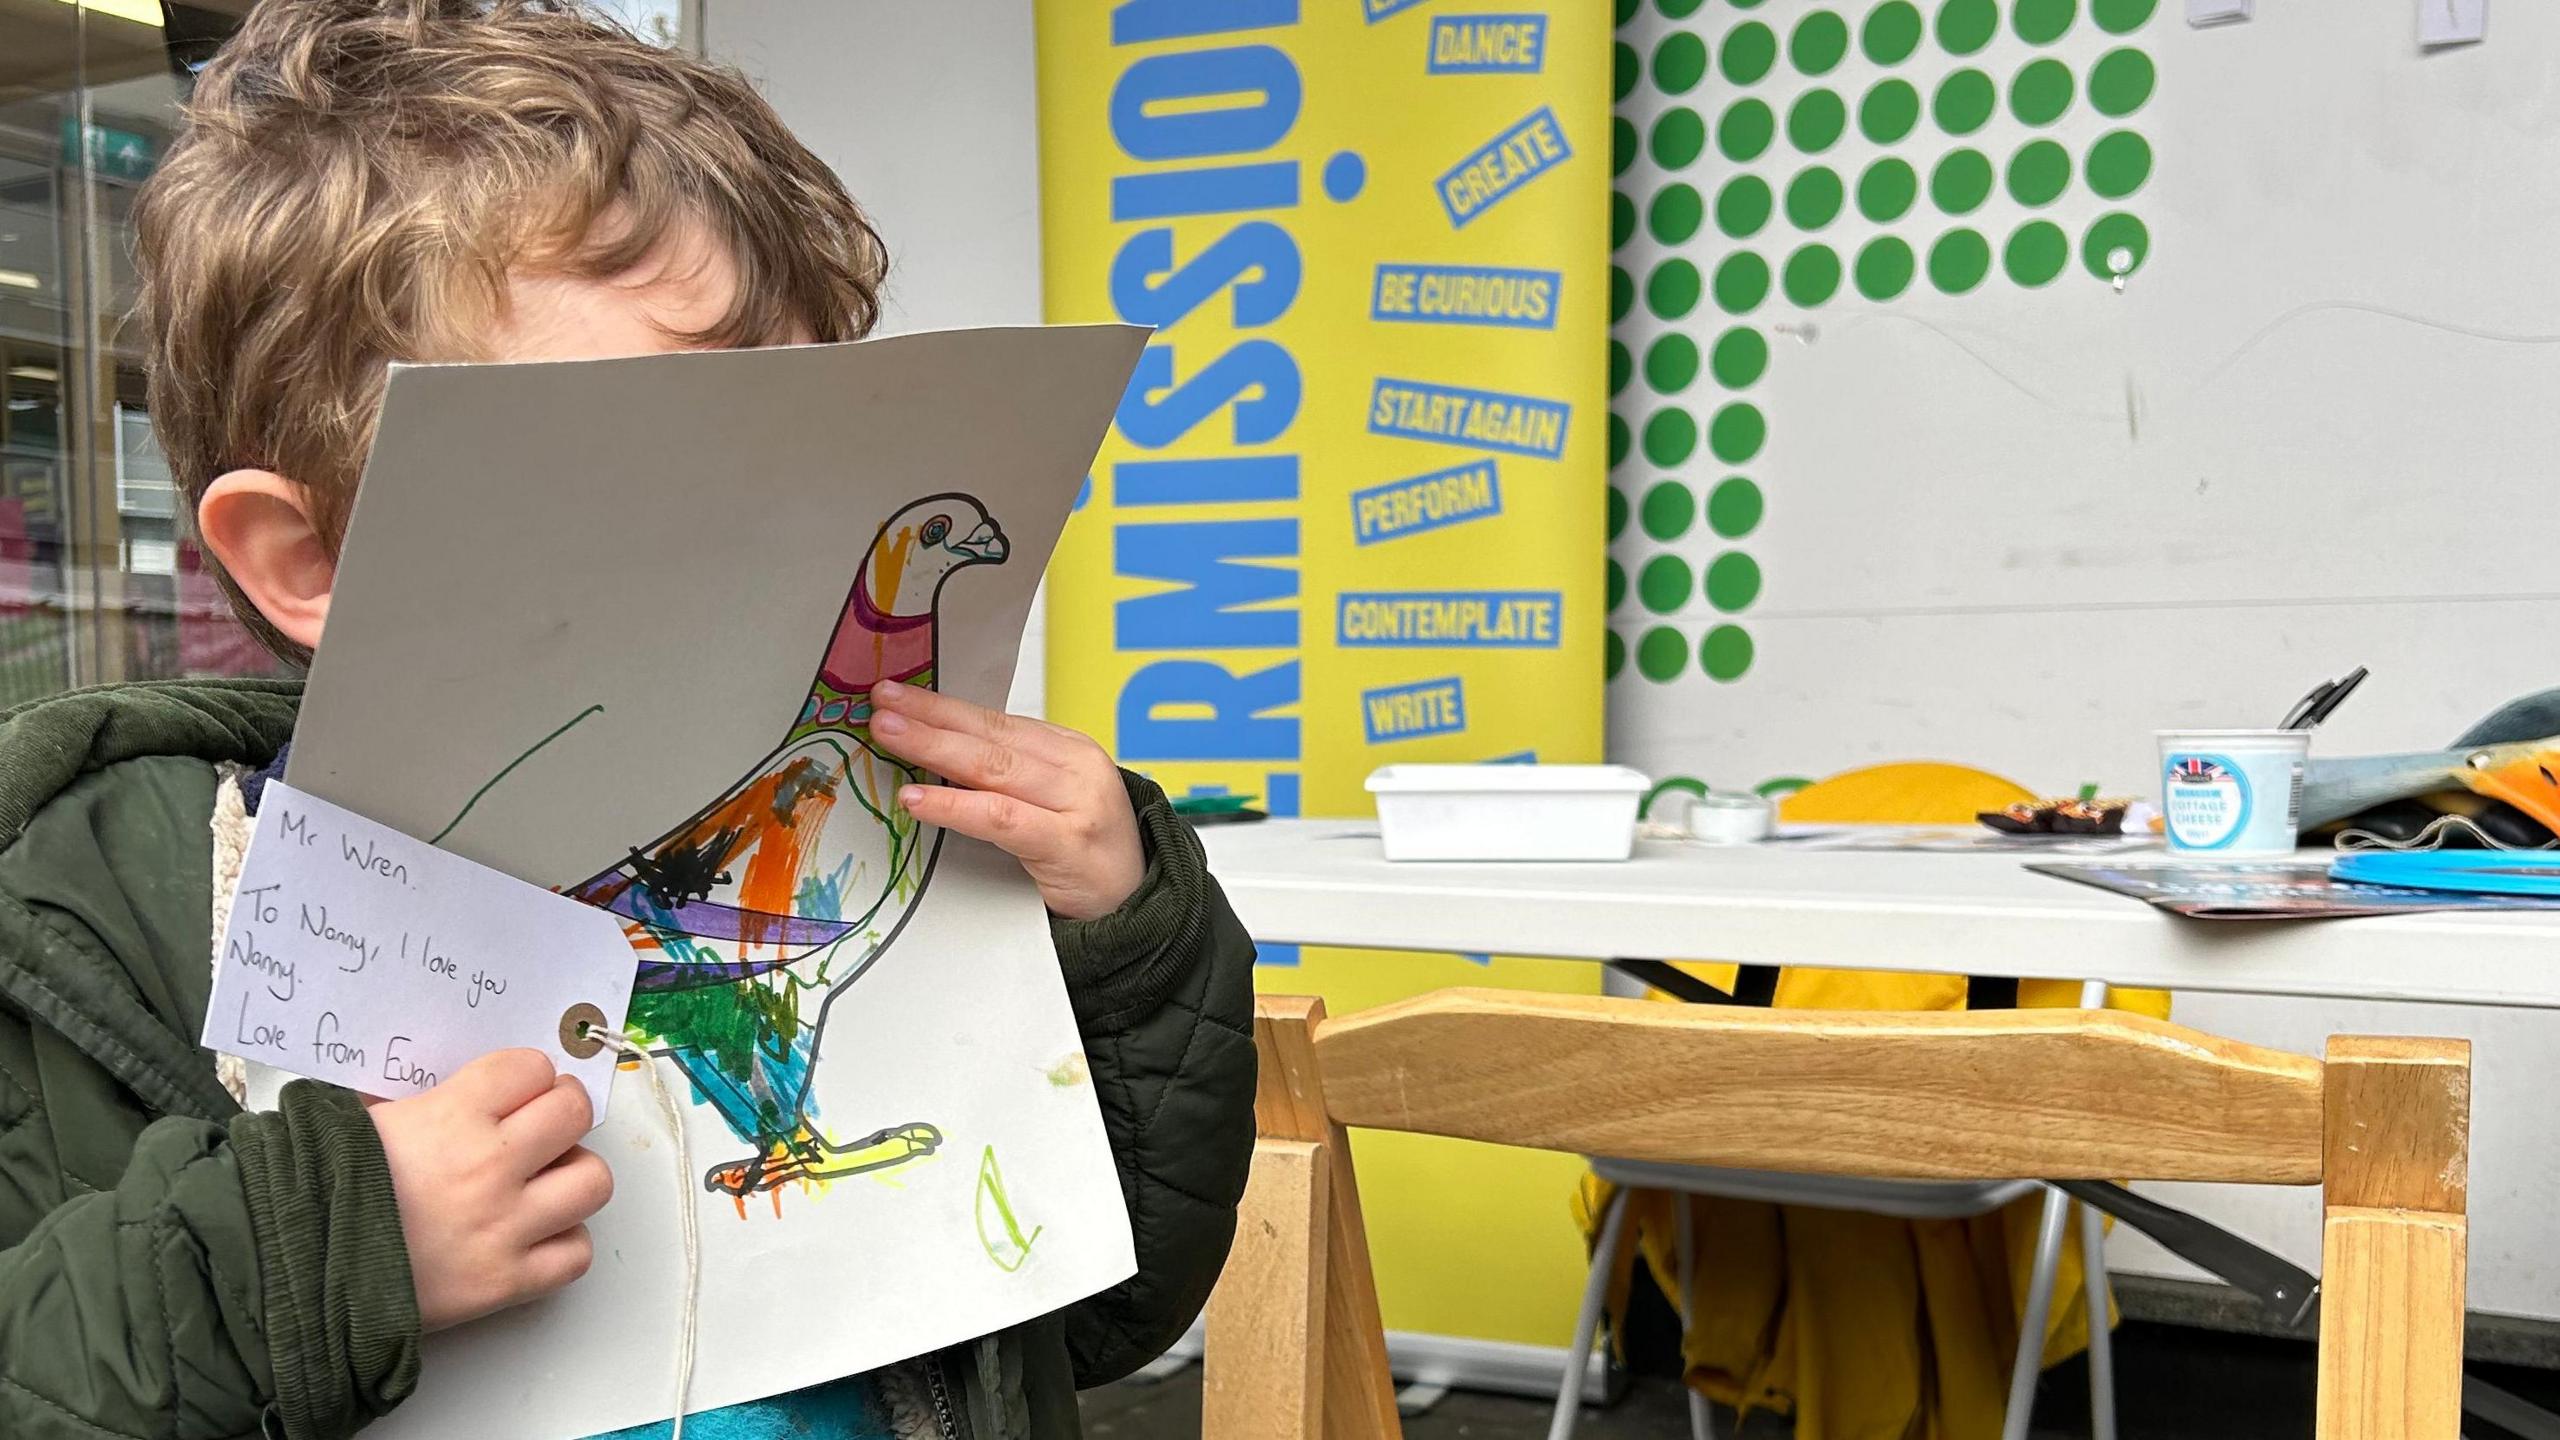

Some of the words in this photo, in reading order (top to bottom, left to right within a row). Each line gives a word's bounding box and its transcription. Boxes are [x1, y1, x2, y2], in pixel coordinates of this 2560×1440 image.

[1434, 24, 1536, 64] DANCE
[1446, 117, 1559, 215] CREATE
[1379, 273, 1416, 312] BE
[1418, 274, 1550, 320] CURIOUS
[1374, 386, 1466, 437] START
[1463, 400, 1561, 451] AGAIN
[1359, 468, 1492, 536] PERFORM
[1343, 600, 1552, 640] CONTEMPLATE
[1368, 686, 1458, 735] WRITE
[280, 810, 319, 846] Mr
[2171, 801, 2228, 811] COTTAGE
[2175, 814, 2222, 825] CHEESE
[241, 884, 281, 924] To
[400, 932, 408, 959] I
[422, 936, 457, 980] love
[467, 971, 507, 1008] you
[236, 990, 288, 1051] Love
[312, 1011, 365, 1068] from
